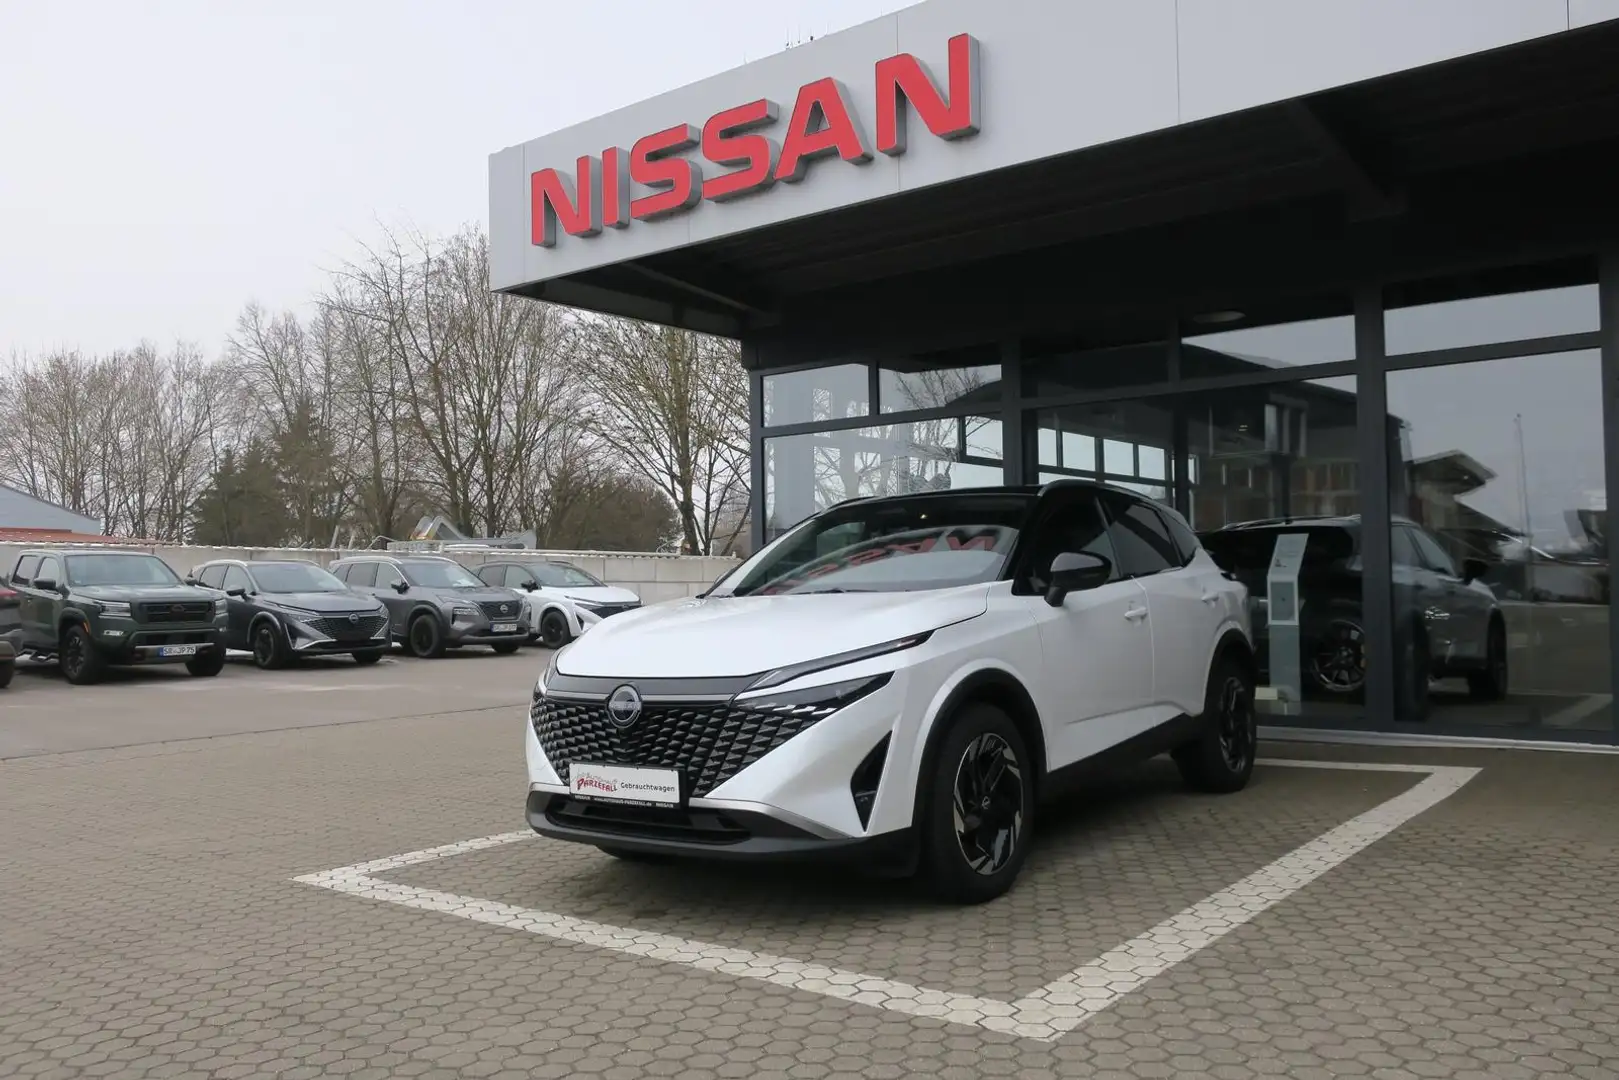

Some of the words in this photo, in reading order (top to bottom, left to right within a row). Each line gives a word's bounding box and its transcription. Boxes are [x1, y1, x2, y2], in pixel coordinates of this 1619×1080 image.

[531, 33, 979, 246] NISSAN
[577, 778, 618, 792] PARZEFALL
[620, 782, 675, 793] Gebrauchtwagen
